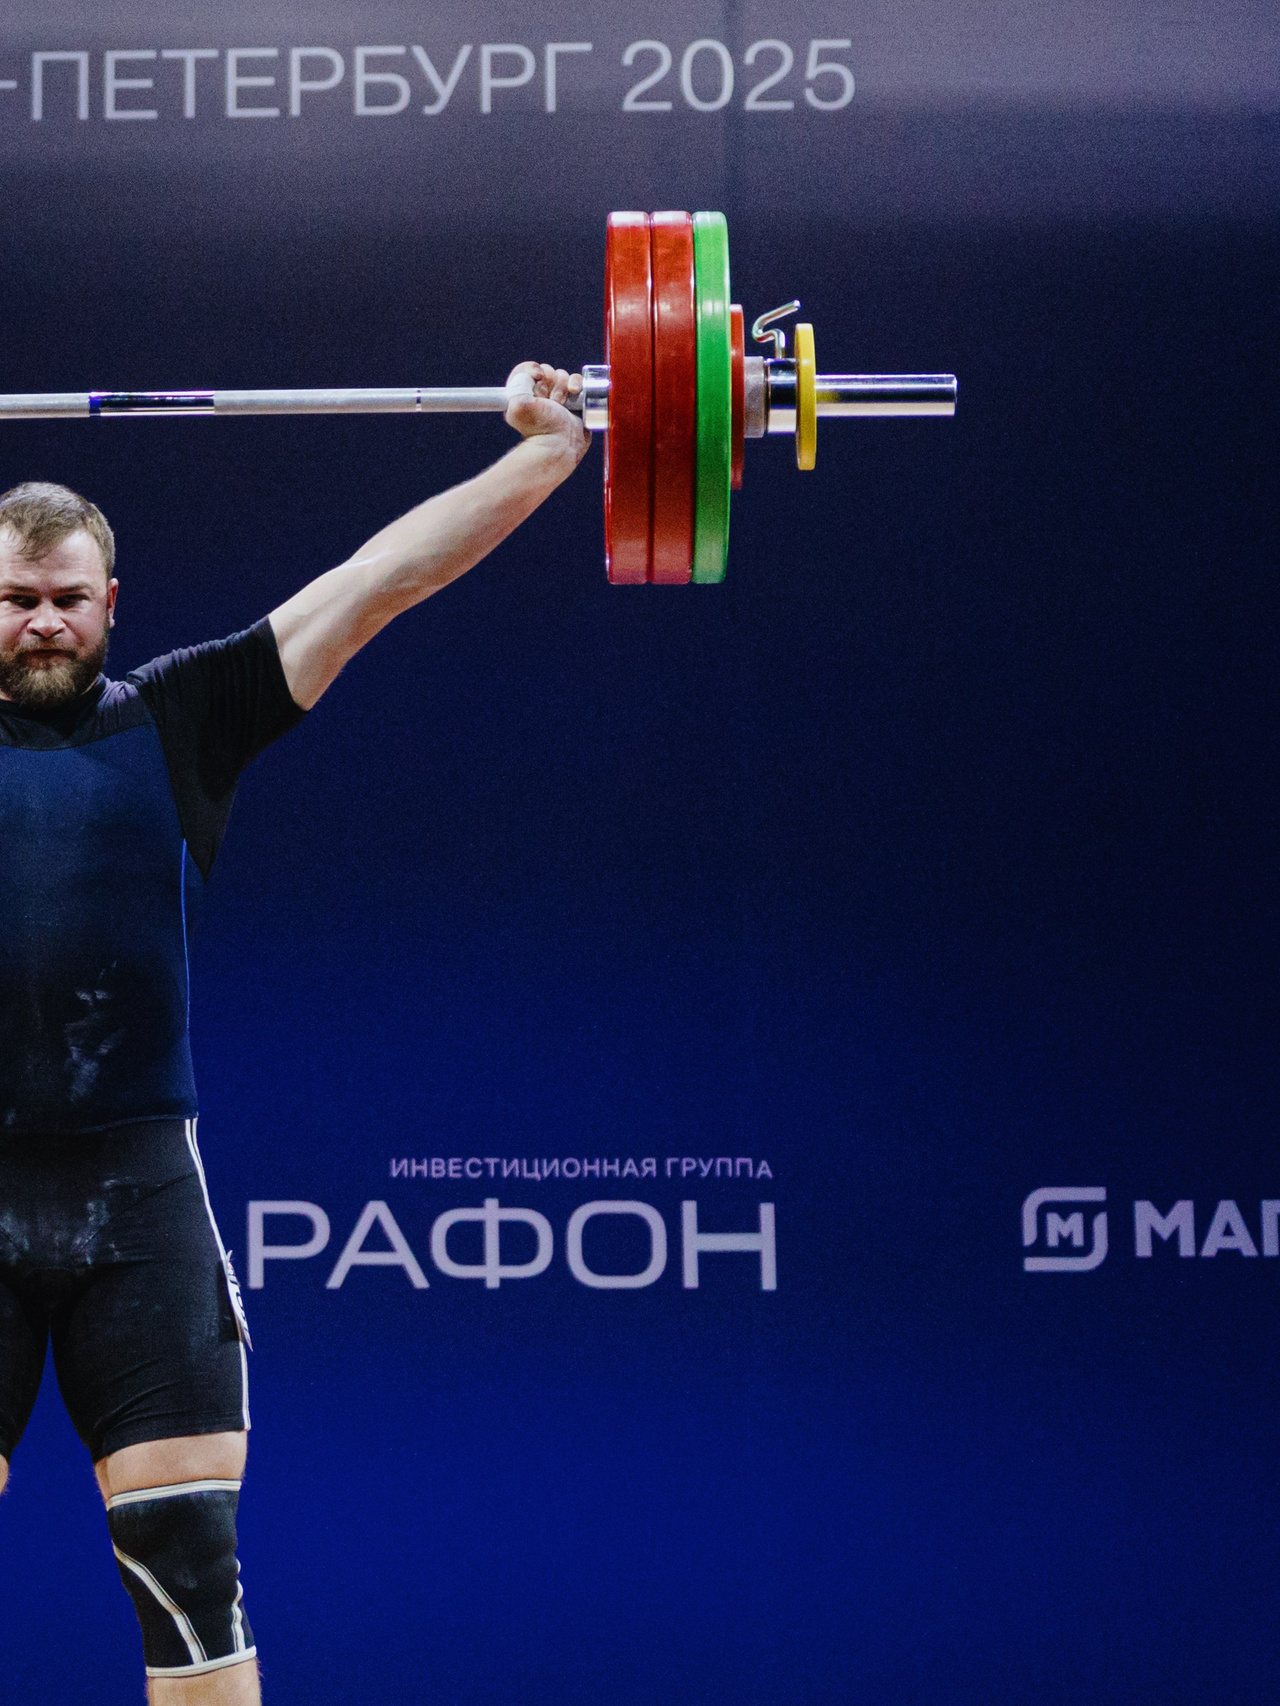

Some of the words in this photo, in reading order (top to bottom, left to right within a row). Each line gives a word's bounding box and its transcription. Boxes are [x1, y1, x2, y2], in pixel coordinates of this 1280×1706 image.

[621, 38, 856, 113] 2025
[389, 1157, 657, 1181] ИНВЕСТИЦИОННАЯ
[665, 1157, 773, 1179] ГРУППА
